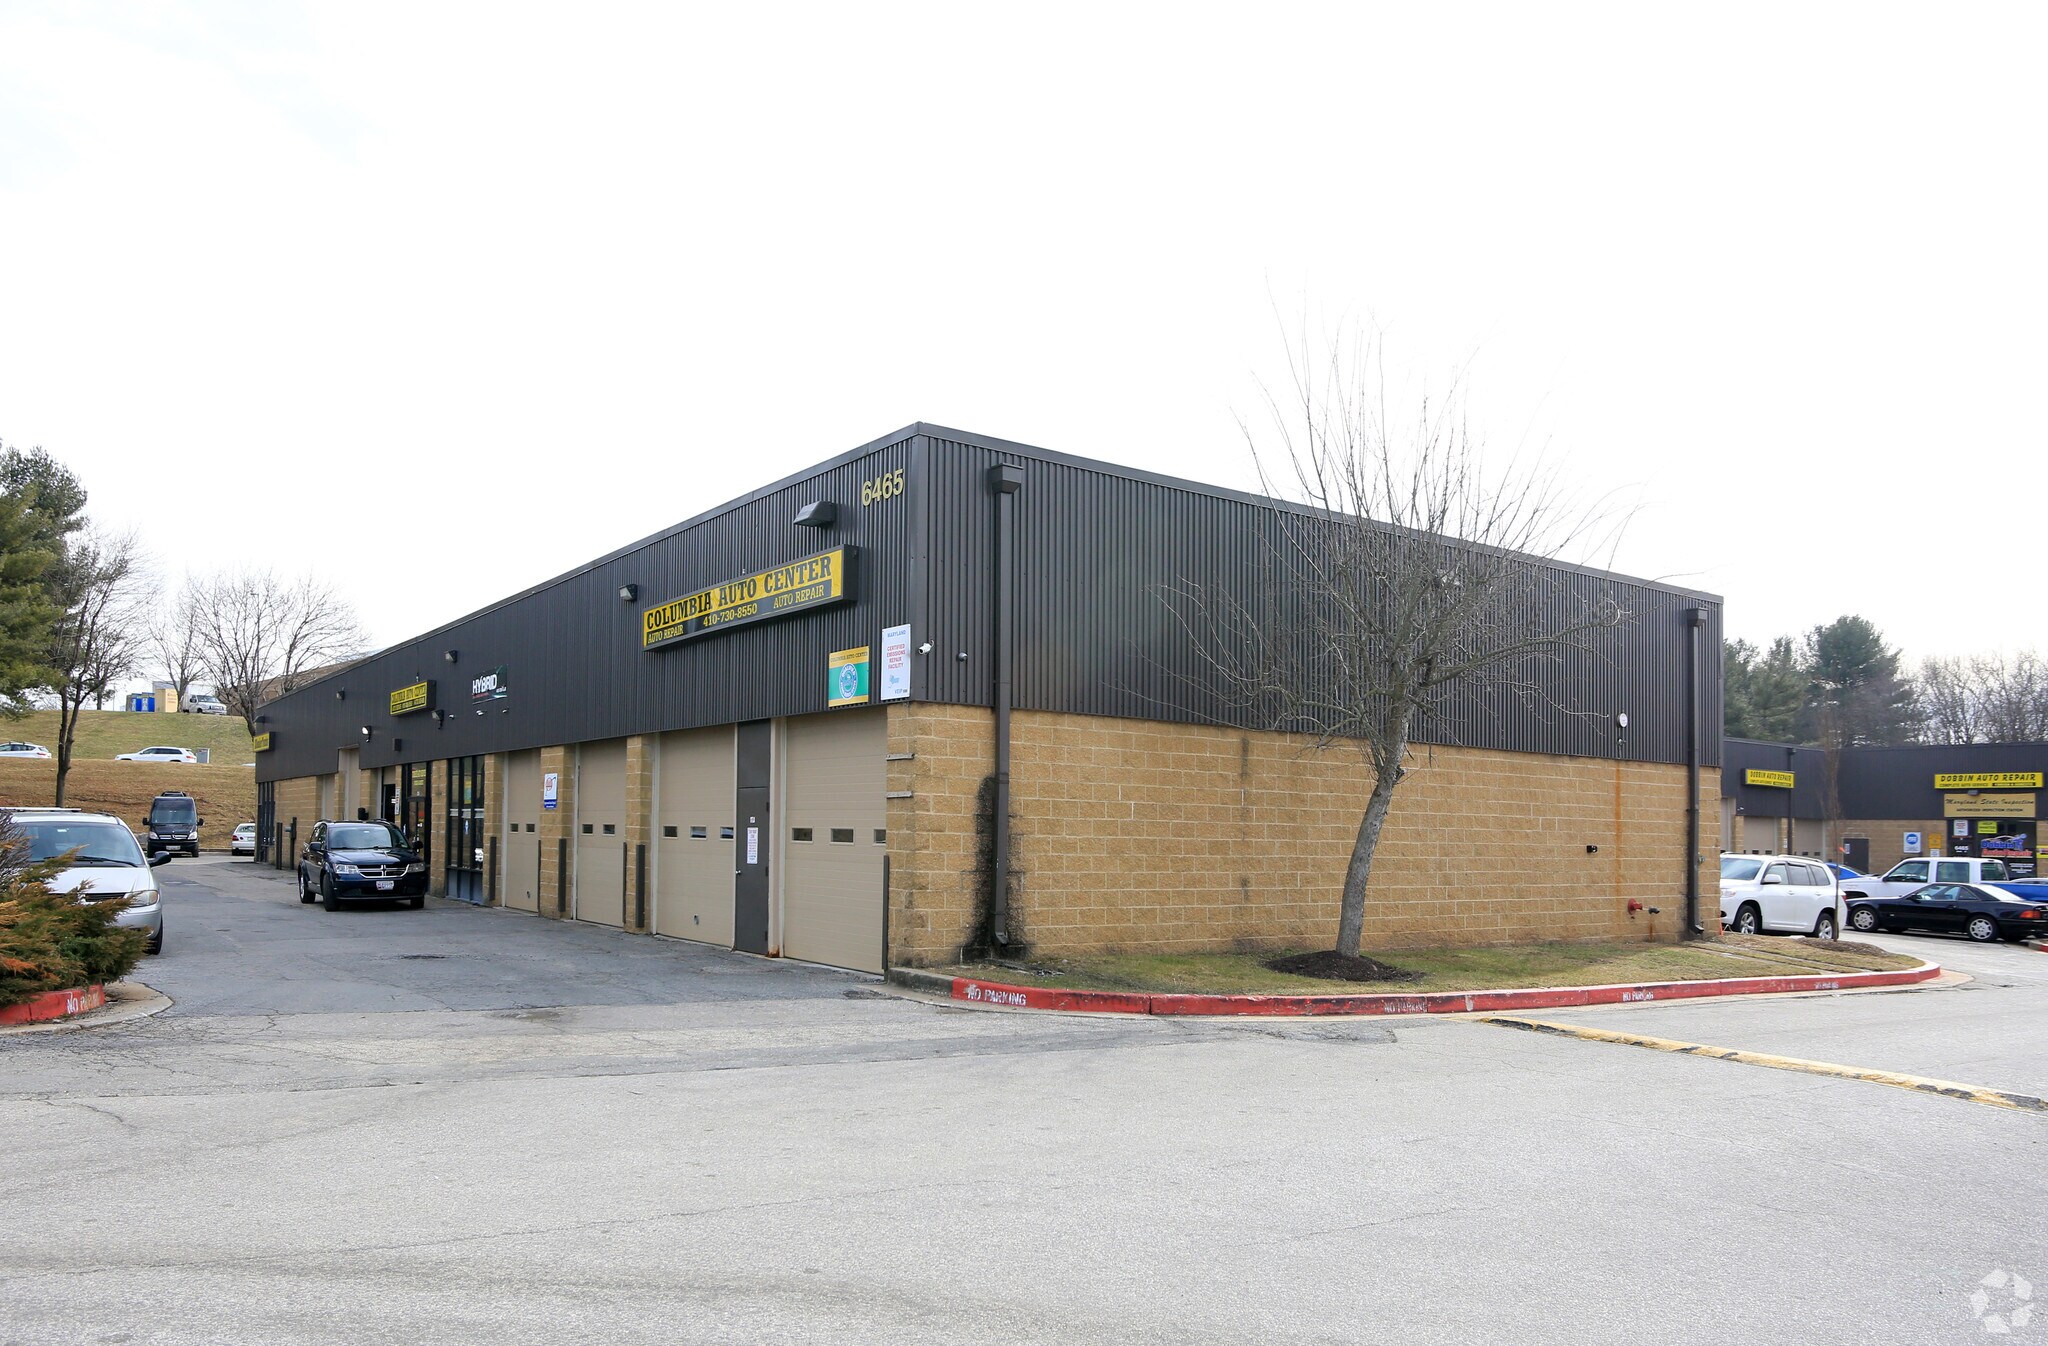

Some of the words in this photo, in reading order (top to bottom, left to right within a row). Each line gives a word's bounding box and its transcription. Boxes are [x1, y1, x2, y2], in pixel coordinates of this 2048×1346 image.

[861, 468, 904, 507] 6465
[646, 591, 713, 630] COLUMBIA
[718, 578, 757, 607] AUTO
[763, 555, 832, 594] CENTER
[773, 596, 794, 609] AUTO
[795, 584, 825, 603] REPAIR
[702, 602, 758, 627] 410-730-8550
[647, 632, 663, 644] AUTO
[663, 625, 684, 640] REPAIR
[887, 629, 906, 638] MARYLAND
[886, 643, 906, 652] CERTIFIED
[886, 649, 906, 658] EMISSIONS
[888, 662, 904, 670] FACILITY
[472, 674, 498, 694] HYBRID
[2002, 773, 2036, 781] REPAIR
[1945, 798, 1977, 806] Maryland
[2000, 798, 2034, 806] Inspection
[985, 989, 1027, 1006] PARKING
